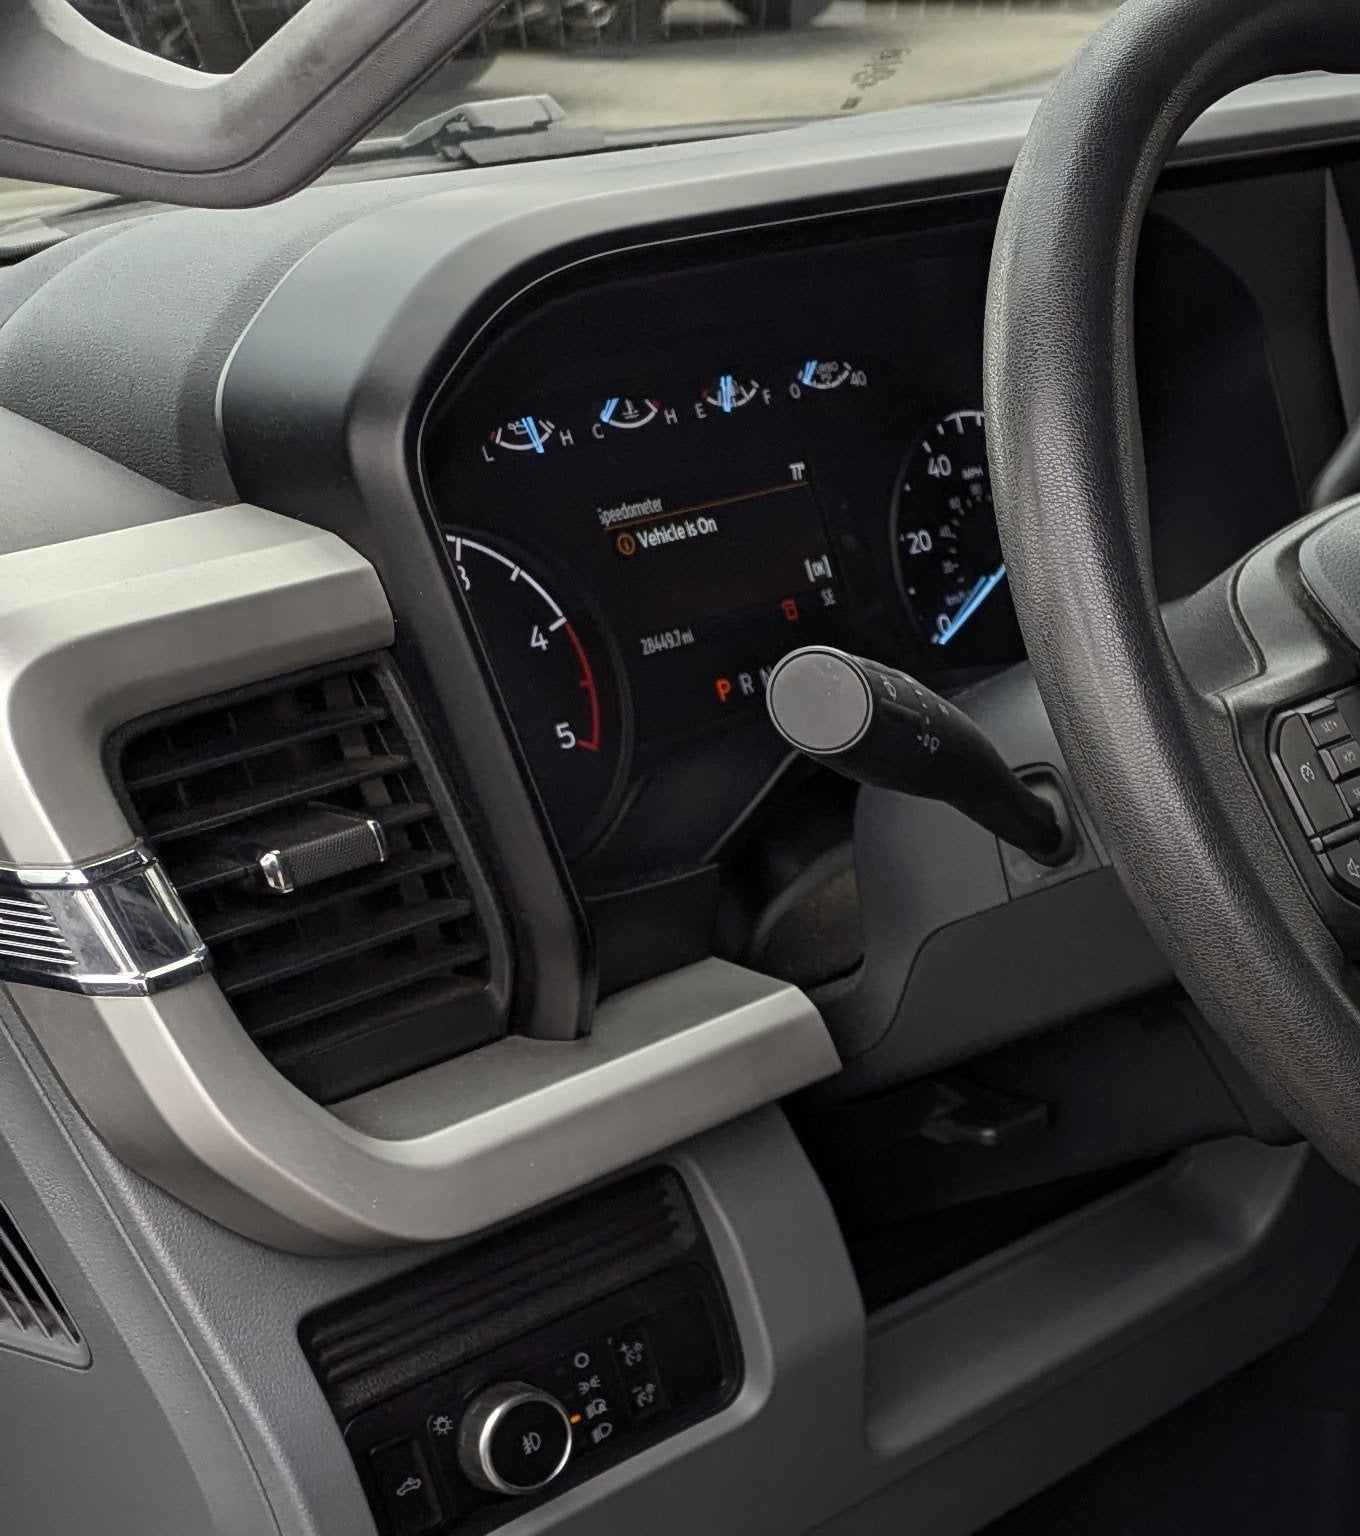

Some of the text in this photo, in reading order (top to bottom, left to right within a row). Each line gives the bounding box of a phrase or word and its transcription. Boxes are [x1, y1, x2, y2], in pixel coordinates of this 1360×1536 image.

[694, 388, 771, 419] E F
[591, 407, 679, 439] C H
[481, 428, 575, 461] L H
[927, 454, 952, 478] 40
[597, 498, 663, 526] Speedometer
[636, 522, 686, 549] Vehicle
[697, 516, 719, 535] On
[905, 529, 933, 555] 20
[530, 624, 549, 651] 4
[936, 612, 952, 634] 0
[714, 677, 731, 702] P
[739, 671, 755, 696] R
[555, 721, 576, 750] 5
